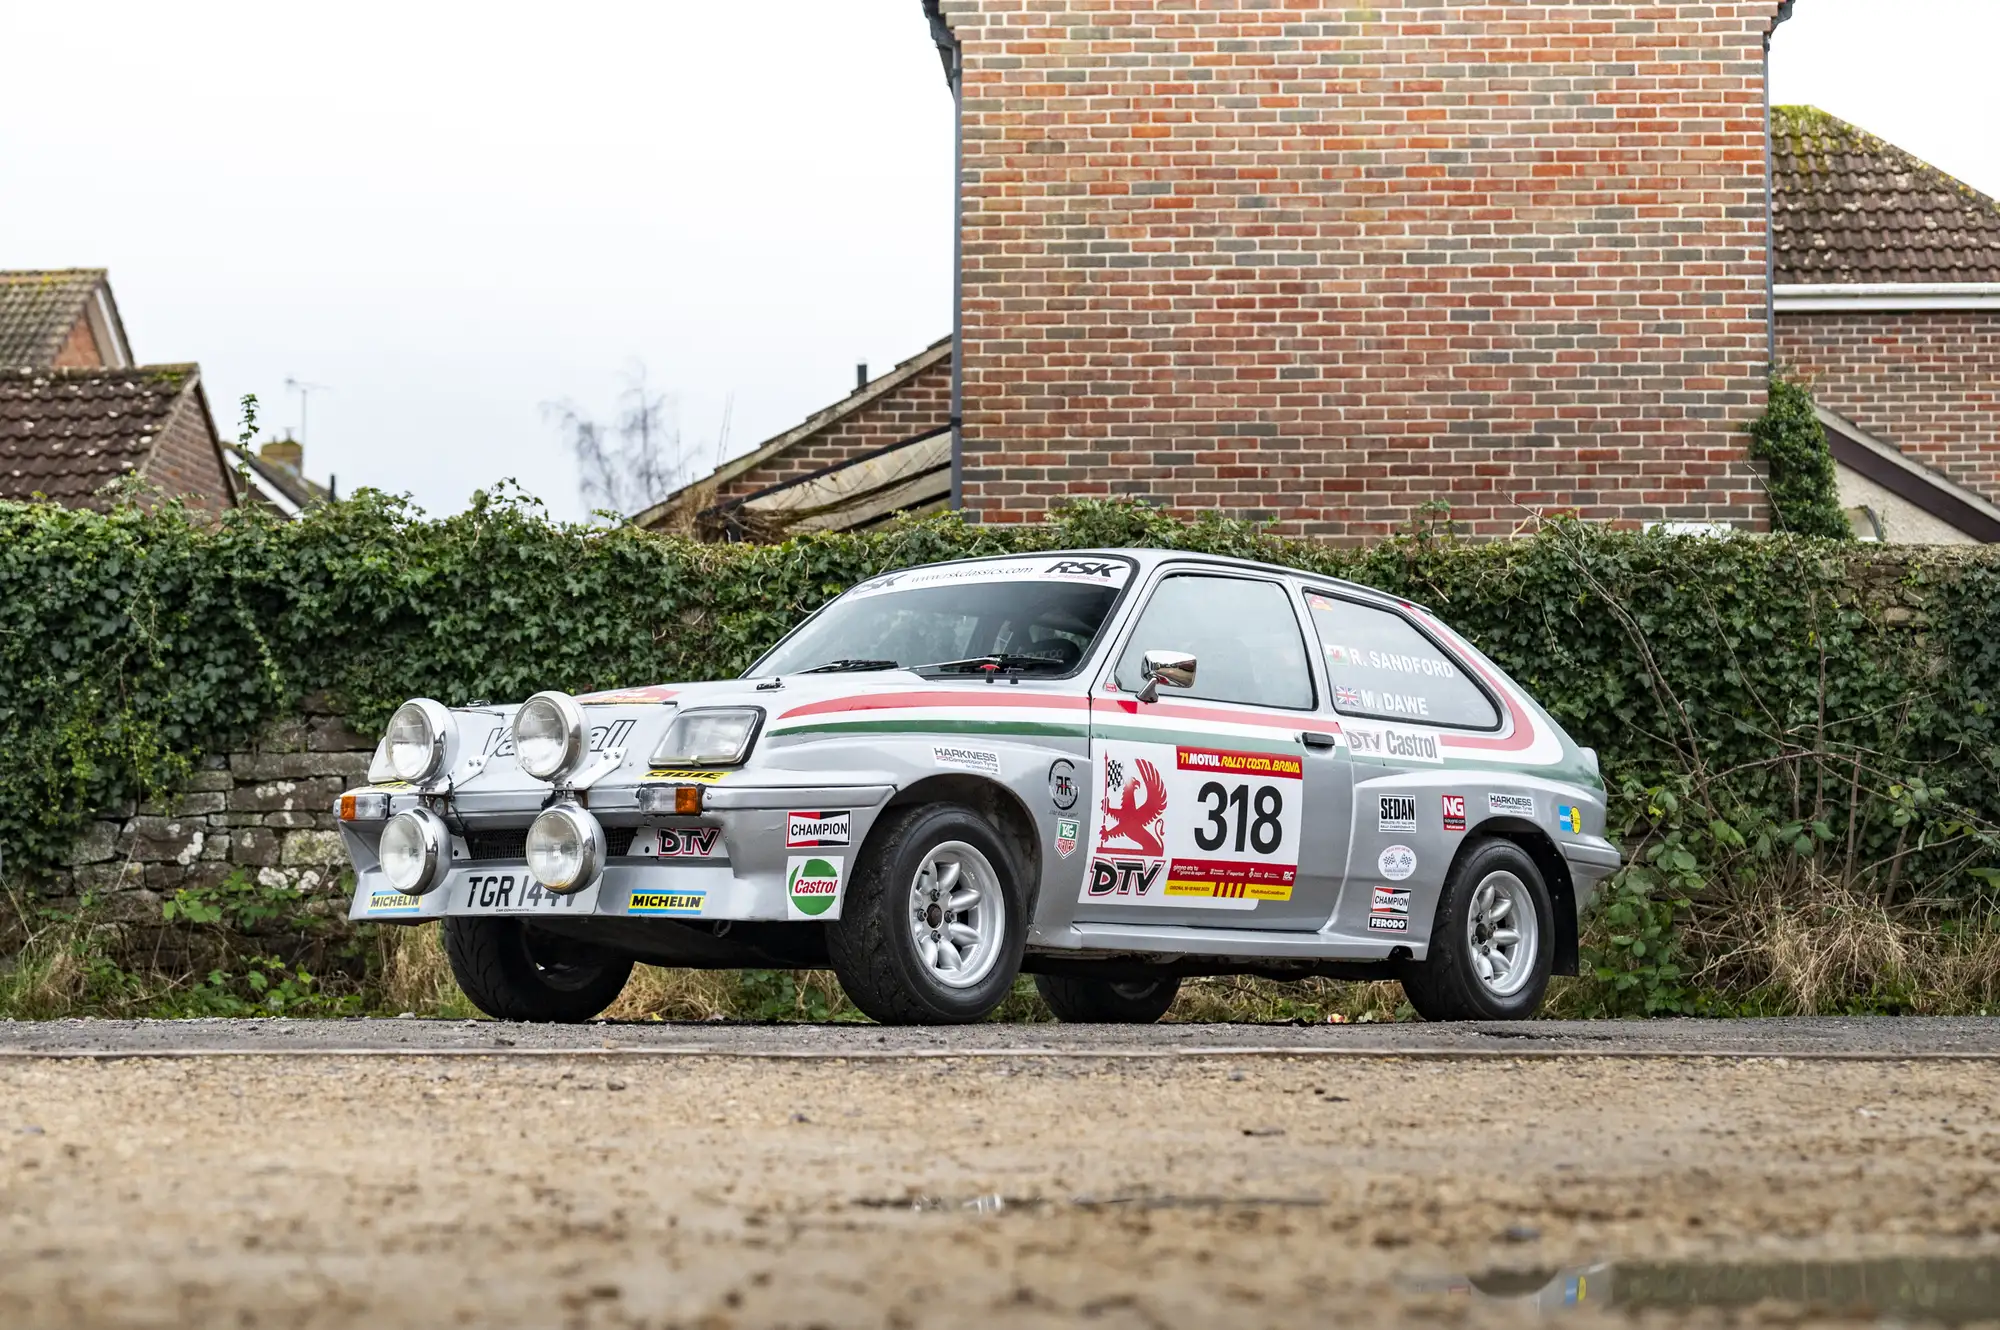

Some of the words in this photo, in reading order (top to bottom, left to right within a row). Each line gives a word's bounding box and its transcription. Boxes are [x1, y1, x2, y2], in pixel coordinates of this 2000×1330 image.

[1044, 561, 1128, 578] RSK
[1349, 648, 1367, 667] R.
[1369, 650, 1455, 678] SANDFORD
[1360, 689, 1380, 709] M.
[1382, 692, 1429, 716] DAWE
[1346, 729, 1380, 751] DTV
[1385, 730, 1437, 758] Castrol
[934, 747, 997, 763] HARKNESS
[948, 756, 983, 766] Competition
[1179, 752, 1188, 764] 71
[1189, 752, 1220, 766] MOTUL
[1220, 756, 1246, 769] RALLY
[1246, 758, 1271, 771] COSTA
[1272, 760, 1300, 774] BRAVA
[1381, 798, 1415, 820] SEDAN
[1443, 797, 1464, 816] NG
[1490, 795, 1532, 807] HARKNESS
[1193, 781, 1283, 855] 318
[791, 822, 848, 836] CHAMPION
[1061, 823, 1074, 838] TAG
[656, 828, 720, 856] DTV
[1058, 838, 1075, 853] HEUER
[1089, 857, 1165, 896] DTV
[467, 876, 515, 907] TGR
[795, 879, 838, 894] Castrol
[370, 895, 420, 907] MICHELIN
[631, 895, 703, 908] MICHELIN
[1375, 895, 1409, 906] CHAMPION
[1371, 918, 1405, 928] FERODO
